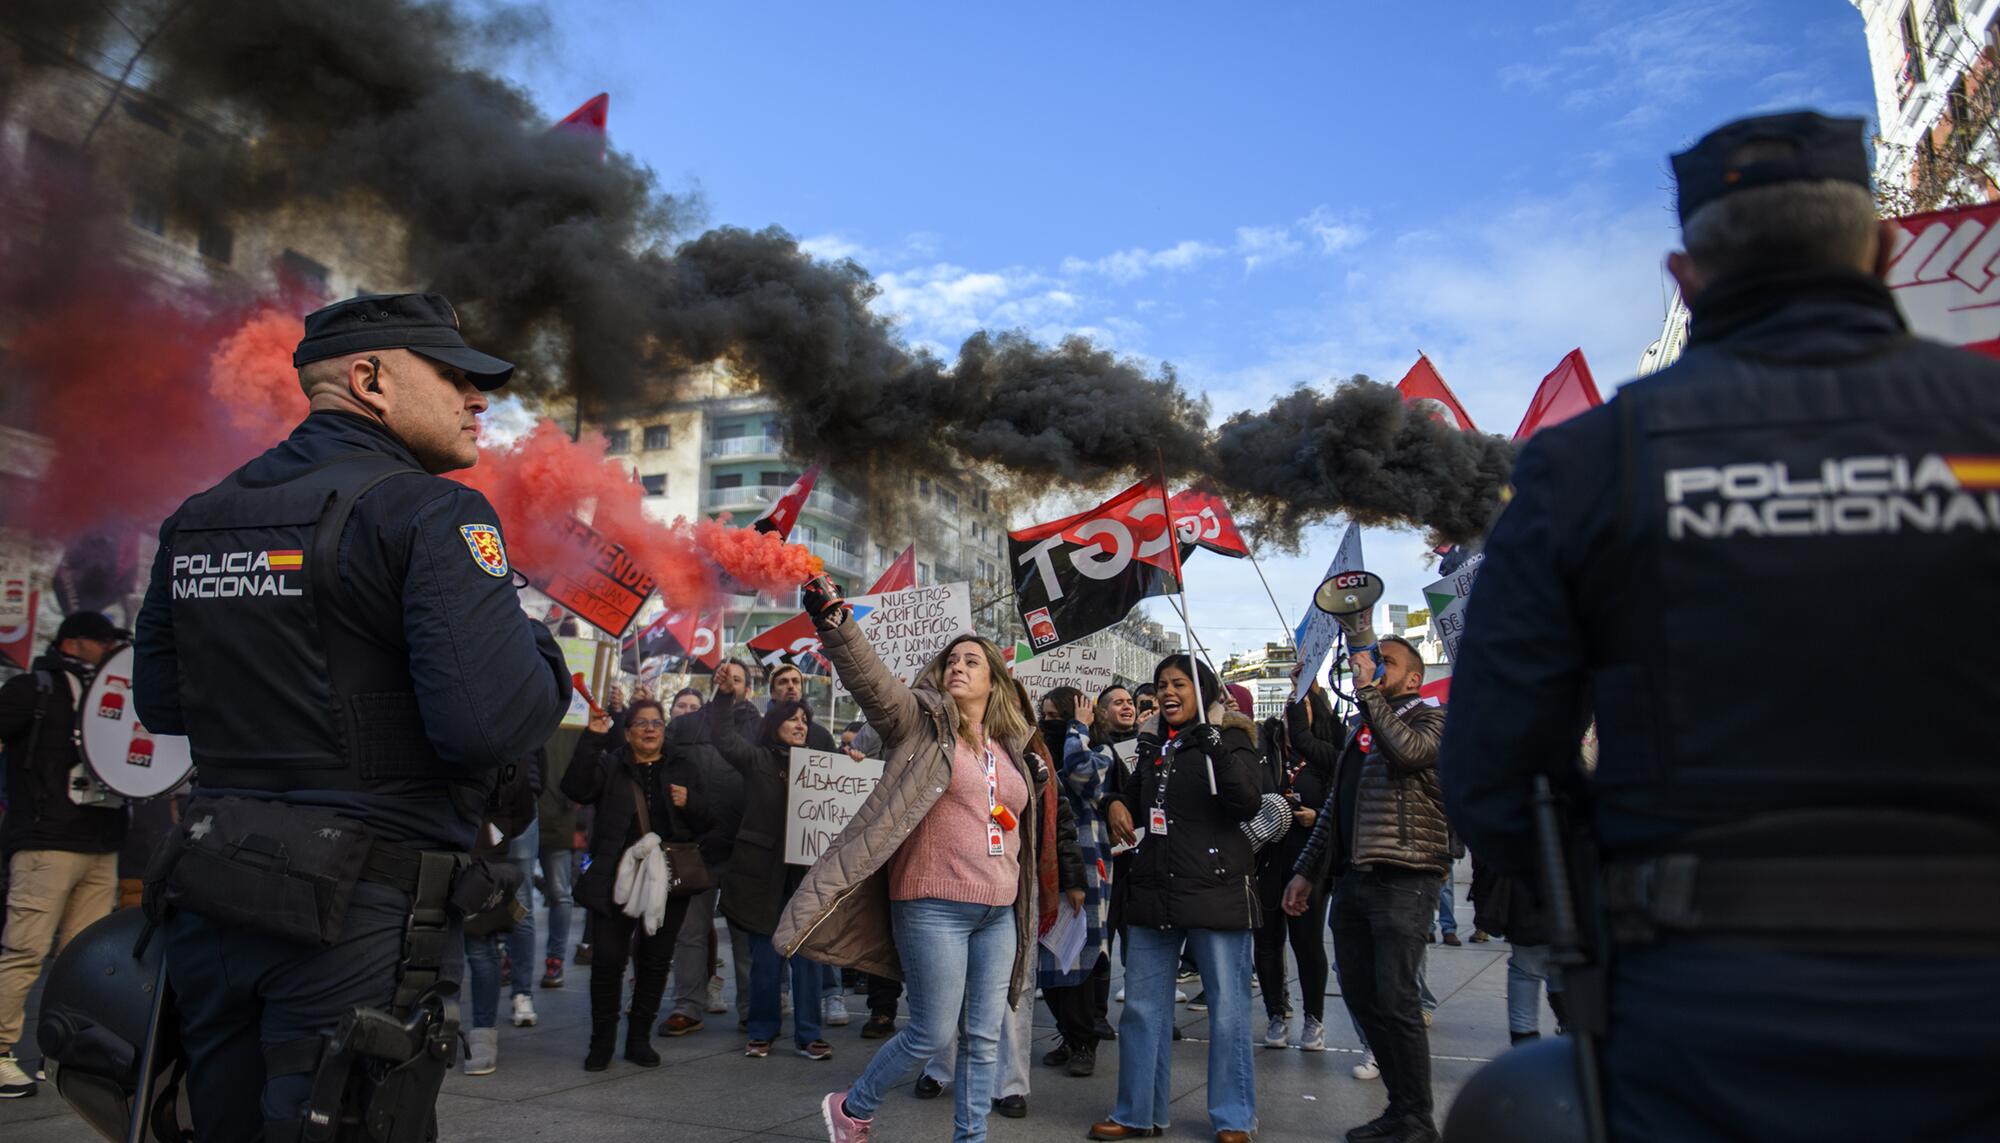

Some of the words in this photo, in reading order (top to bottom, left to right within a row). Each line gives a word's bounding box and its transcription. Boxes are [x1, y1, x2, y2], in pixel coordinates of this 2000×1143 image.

[172, 574, 303, 600] NACIONAL
[1337, 575, 1367, 588] CGT
[880, 586, 951, 608] NUESTROS
[870, 600, 945, 626] SACRIFICIOS
[864, 627, 881, 641] SUS
[886, 616, 959, 640] BENEFICIOS
[892, 641, 900, 654] A
[1081, 649, 1097, 661] EN
[1041, 658, 1071, 673] LUCHA
[1075, 665, 1111, 677] MIENTRAS
[100, 705, 122, 720] CGT
[128, 753, 153, 767] CGT
[795, 765, 869, 796] ALBACETE
[799, 798, 853, 825] CONTRA
